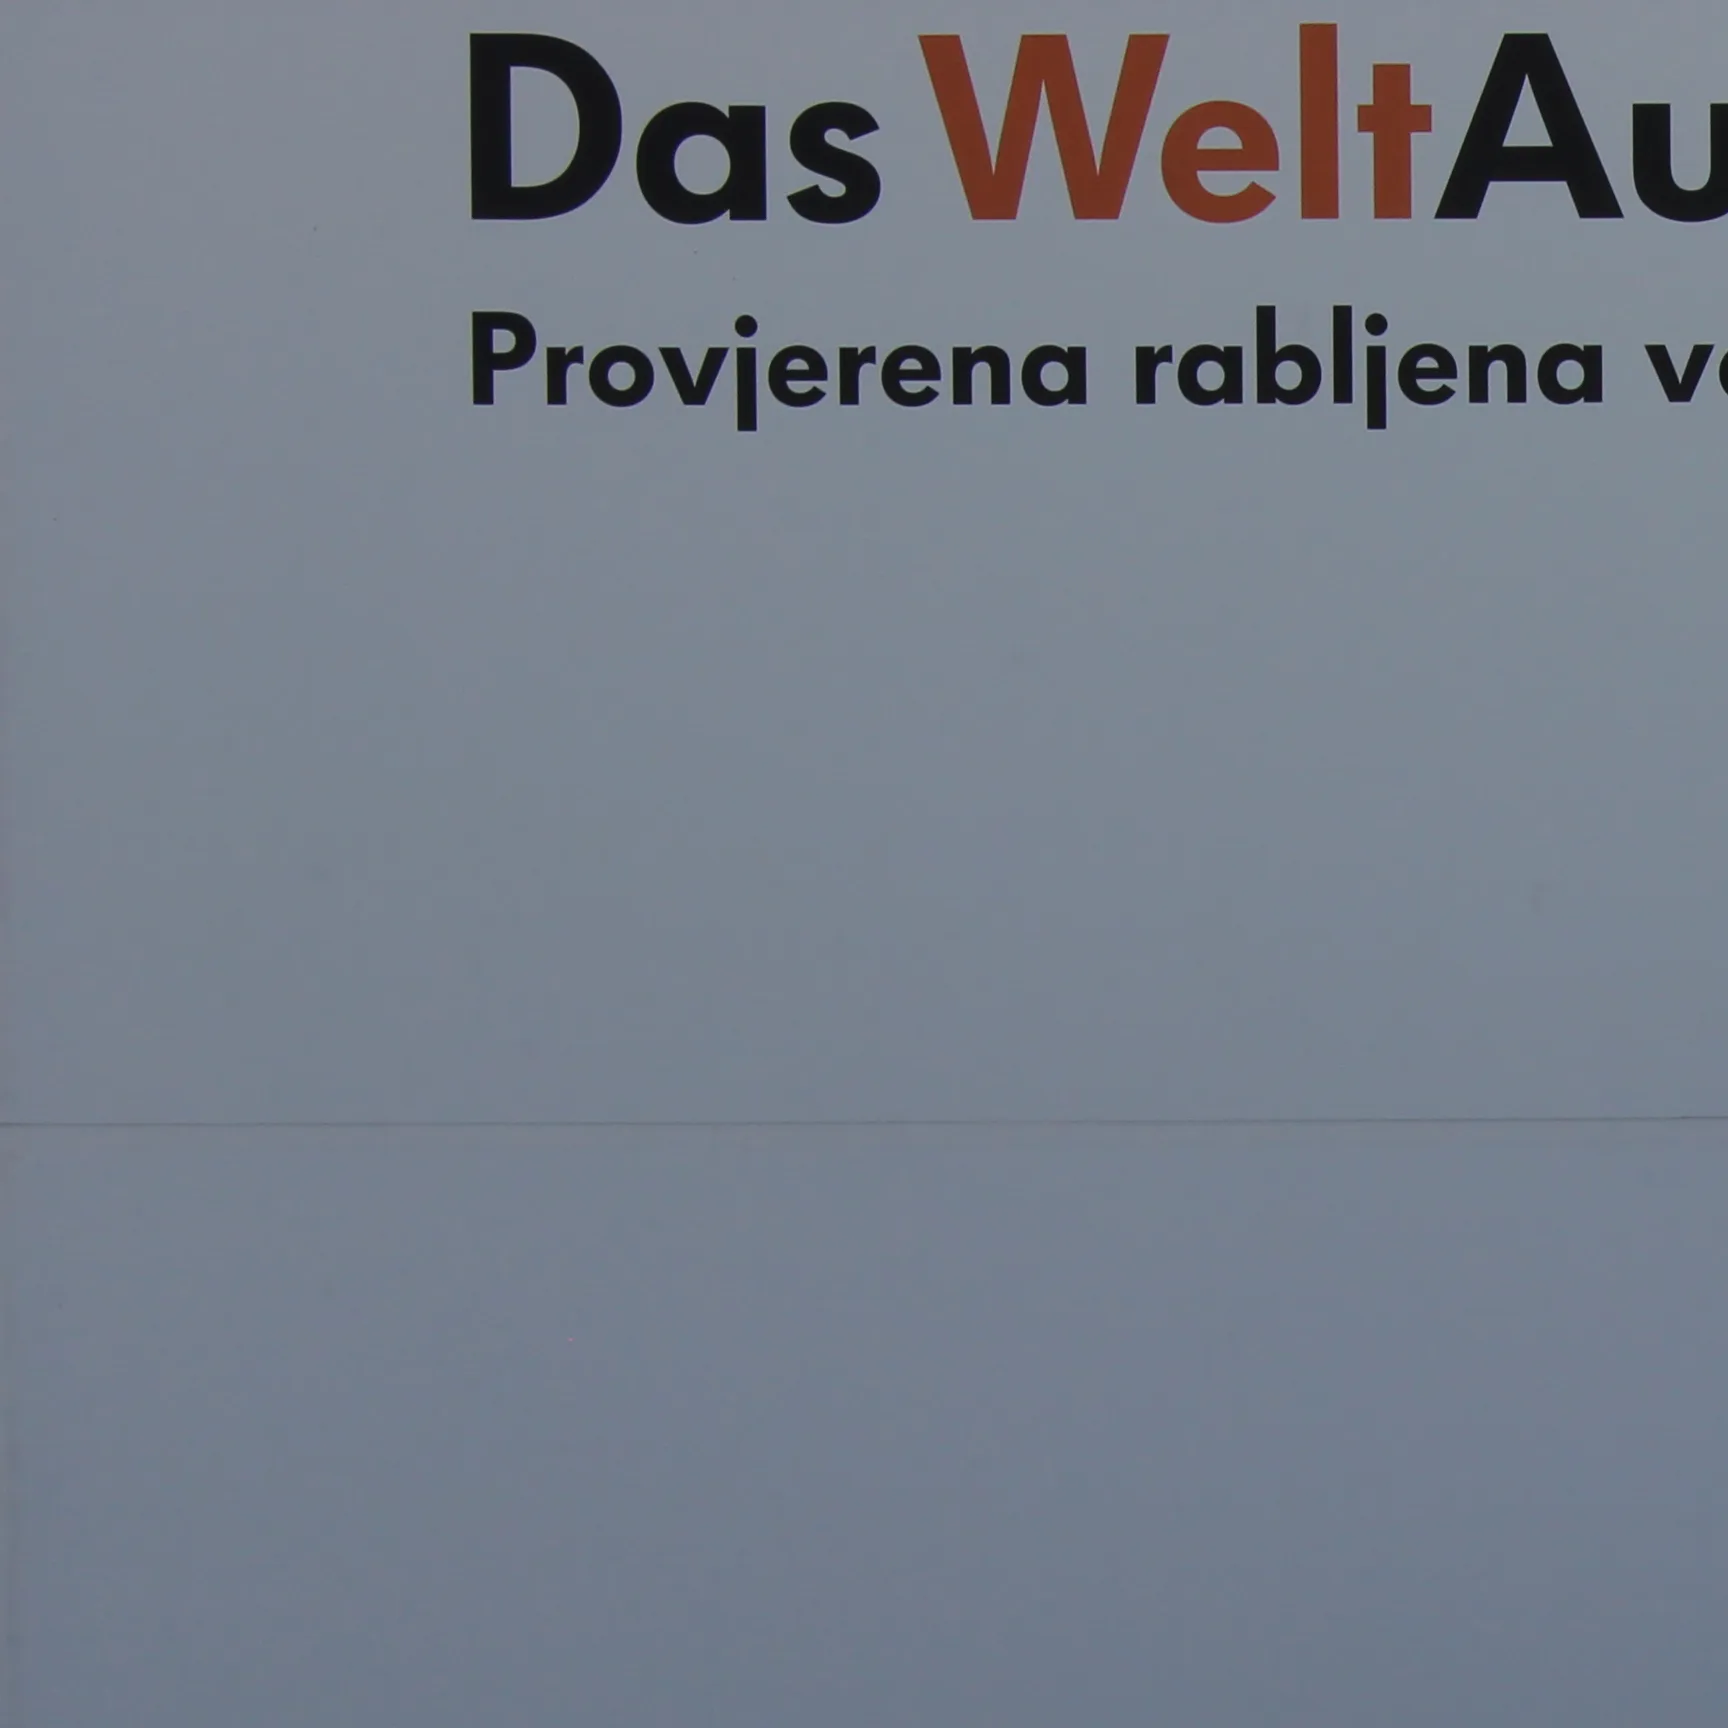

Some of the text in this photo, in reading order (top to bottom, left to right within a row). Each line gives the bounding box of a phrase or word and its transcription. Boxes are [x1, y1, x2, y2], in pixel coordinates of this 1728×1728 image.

[469, 32, 881, 225] Das
[471, 311, 1087, 432] Provjerena
[1135, 304, 1603, 430] rabljena
